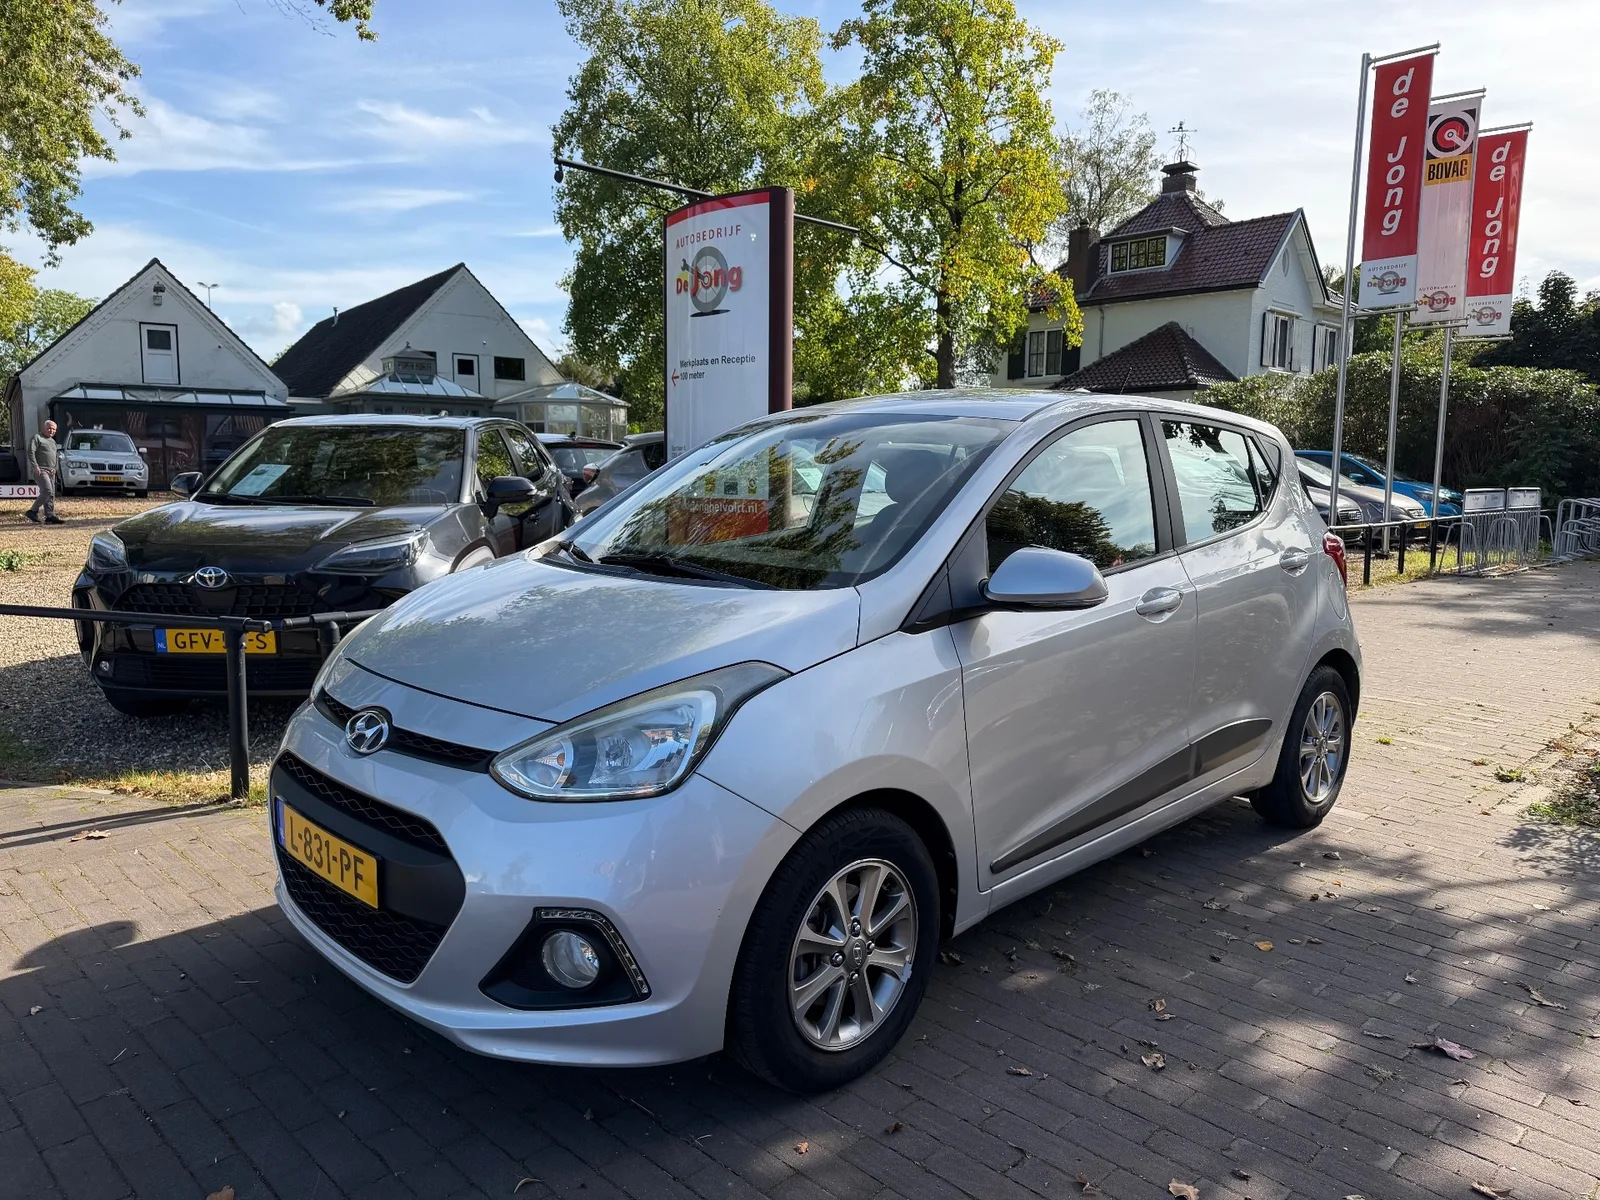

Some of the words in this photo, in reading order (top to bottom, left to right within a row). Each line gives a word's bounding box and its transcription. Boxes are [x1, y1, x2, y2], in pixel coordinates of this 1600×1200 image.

[1392, 67, 1415, 118] de
[1427, 159, 1468, 182] BOVAG
[1489, 141, 1511, 182] de
[1381, 136, 1408, 236] Jong
[676, 224, 741, 249] AUTOBEDRIJF
[1479, 197, 1503, 279] Jong
[1367, 263, 1408, 272] AUTOBEDRIJF
[676, 277, 689, 295] De
[690, 266, 742, 296] Jong
[680, 357, 709, 369] Werkplaats
[711, 357, 719, 365] en
[721, 353, 756, 366] Receptie
[680, 371, 688, 381] 100
[689, 371, 705, 380] meter
[9, 487, 37, 496] JON
[174, 632, 268, 650] GFV--S
[290, 816, 364, 892] L-831-PF
